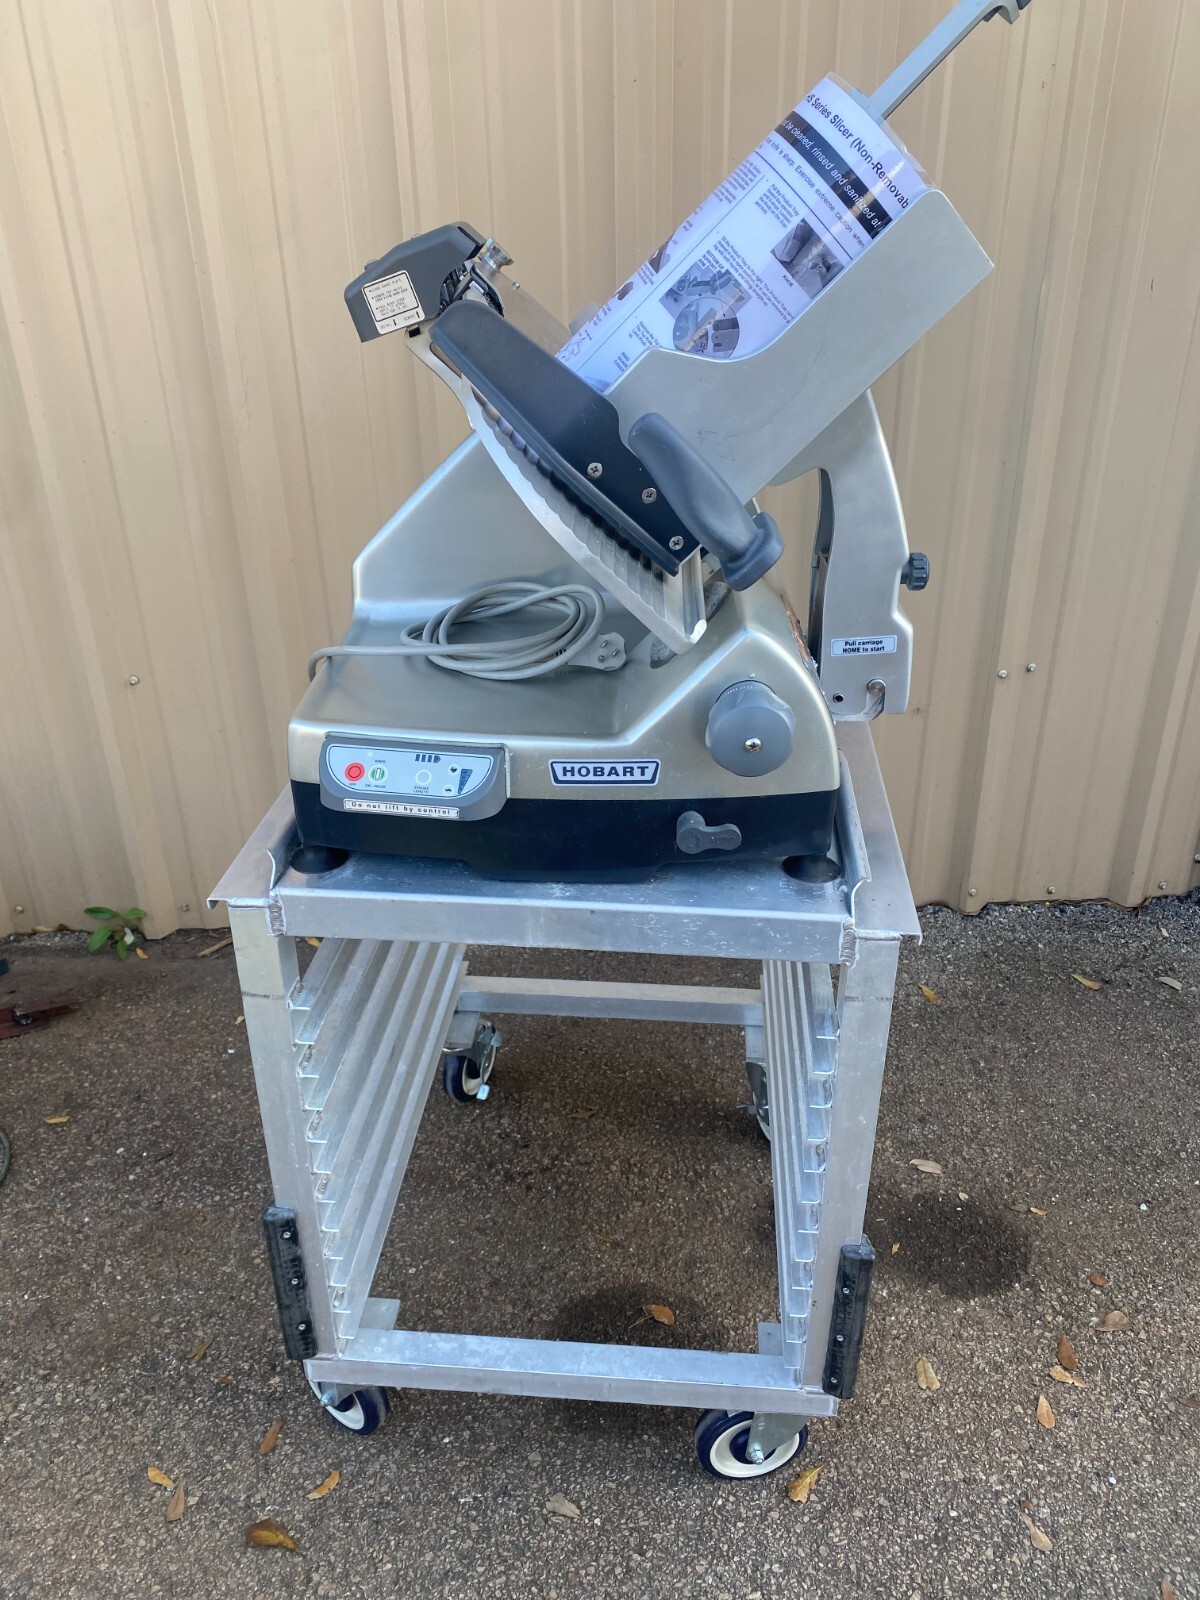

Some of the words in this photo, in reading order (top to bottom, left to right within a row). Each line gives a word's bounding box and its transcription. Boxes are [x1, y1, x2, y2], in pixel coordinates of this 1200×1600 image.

[811, 97, 831, 118] Series
[829, 114, 852, 139] Slicer
[790, 125, 814, 149] cleaned,
[811, 146, 834, 170] rinsed
[830, 168, 847, 185] and
[843, 184, 874, 219] sanitized
[871, 217, 880, 227] at
[782, 153, 795, 167] sharp.
[795, 165, 815, 187] Exercise
[815, 188, 834, 211] extreme
[834, 211, 853, 232] caution
[851, 232, 865, 248] when
[562, 765, 650, 778] HOBART
[417, 808, 451, 816] control
